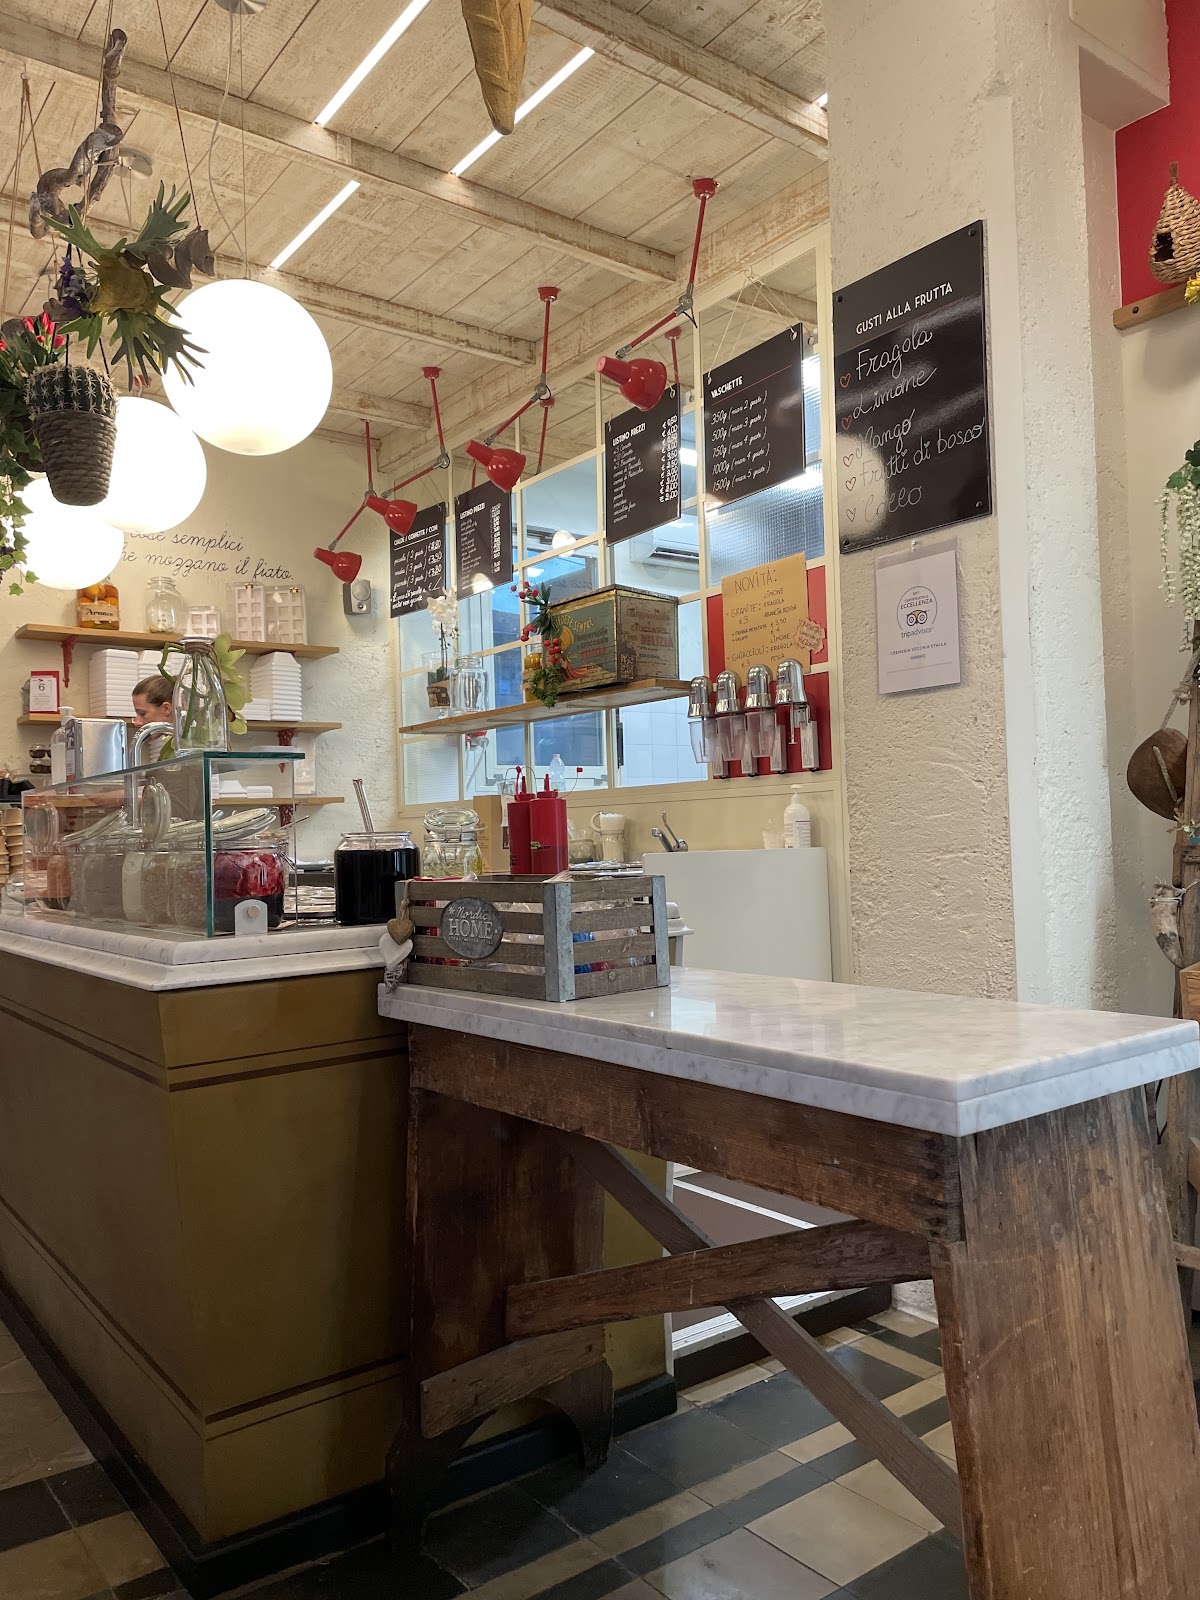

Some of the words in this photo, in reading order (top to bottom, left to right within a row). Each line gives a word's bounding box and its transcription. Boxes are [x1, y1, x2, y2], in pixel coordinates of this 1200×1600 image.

[856, 310, 882, 335] GUSTI
[886, 301, 911, 322] ALLA
[915, 281, 953, 308] FRUTTA
[856, 323, 933, 381] Fragola
[711, 376, 743, 398] VASCHETTE
[853, 367, 937, 419] Limone
[711, 408, 728, 426] 350g
[613, 431, 630, 446] LISTINO
[631, 422, 646, 437] PREZZI
[711, 425, 728, 442] 500g
[856, 408, 916, 459] Mango
[712, 444, 727, 459] 750g
[859, 449, 909, 487] Frutti
[913, 436, 931, 465] di
[937, 416, 985, 453] bosco
[712, 459, 730, 476] 1000g
[712, 476, 731, 492] 1500g
[460, 508, 473, 519] LISTINO
[171, 531, 244, 554] semplici
[122, 542, 138, 562] he
[145, 554, 228, 577] mozzano
[235, 557, 248, 575] il
[252, 558, 295, 582] fiato.
[764, 588, 784, 599] LIMONE
[764, 598, 785, 608] FRAGOLA
[764, 607, 782, 618] ARANCIA
[782, 604, 797, 614] ROSSA
[900, 598, 933, 610] ECCELLENZA
[86, 608, 113, 616] Arance
[574, 617, 595, 633] SEMPRE
[901, 627, 933, 638] tripadvisor
[770, 633, 791, 644] LIMONE
[770, 642, 793, 653] FRAGOLA
[891, 648, 911, 656] CREMERIA
[770, 652, 785, 662] PESCA
[38, 683, 45, 691] 6
[457, 906, 488, 920] Nordic
[449, 918, 493, 939] HOME
